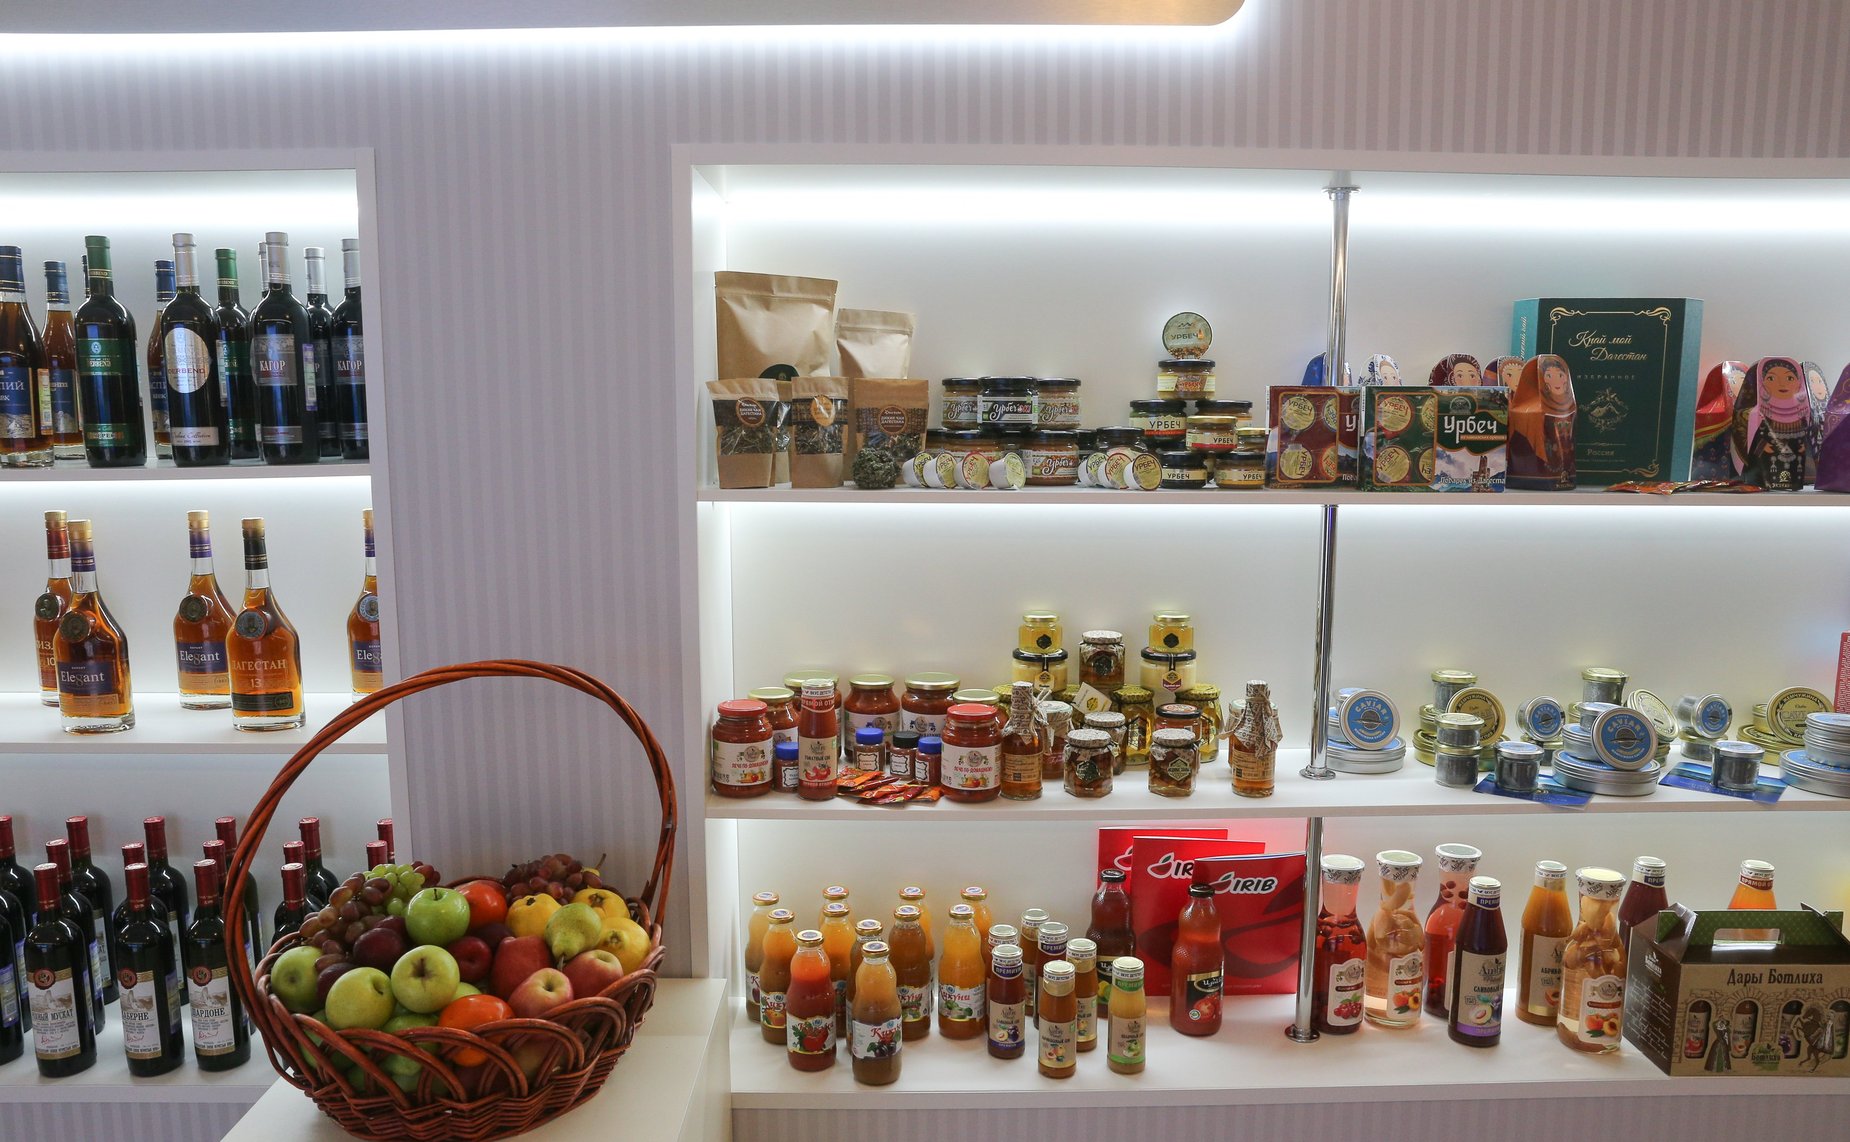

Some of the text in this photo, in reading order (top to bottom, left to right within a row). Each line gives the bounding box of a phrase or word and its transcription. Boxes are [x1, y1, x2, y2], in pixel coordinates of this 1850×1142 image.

[1568, 330, 1633, 349] Край мой
[1590, 347, 1648, 362] Дагестан
[259, 360, 286, 372] КАГОР
[337, 360, 363, 371] КАГОР
[1287, 399, 1313, 415] УРБЕЧ
[1149, 420, 1181, 429] УРБЕЧ
[1443, 415, 1497, 444] Урбеч
[180, 650, 220, 664] Elegant
[60, 670, 105, 687] Elegant
[250, 678, 263, 688] 13
[1355, 700, 1388, 715] CAVIAR
[1607, 718, 1642, 733] CAVIAR
[1232, 878, 1276, 892] IRIB
[1741, 876, 1766, 887] ПРЯМОЙ
[1727, 968, 1824, 987] Дары Ботлиха
